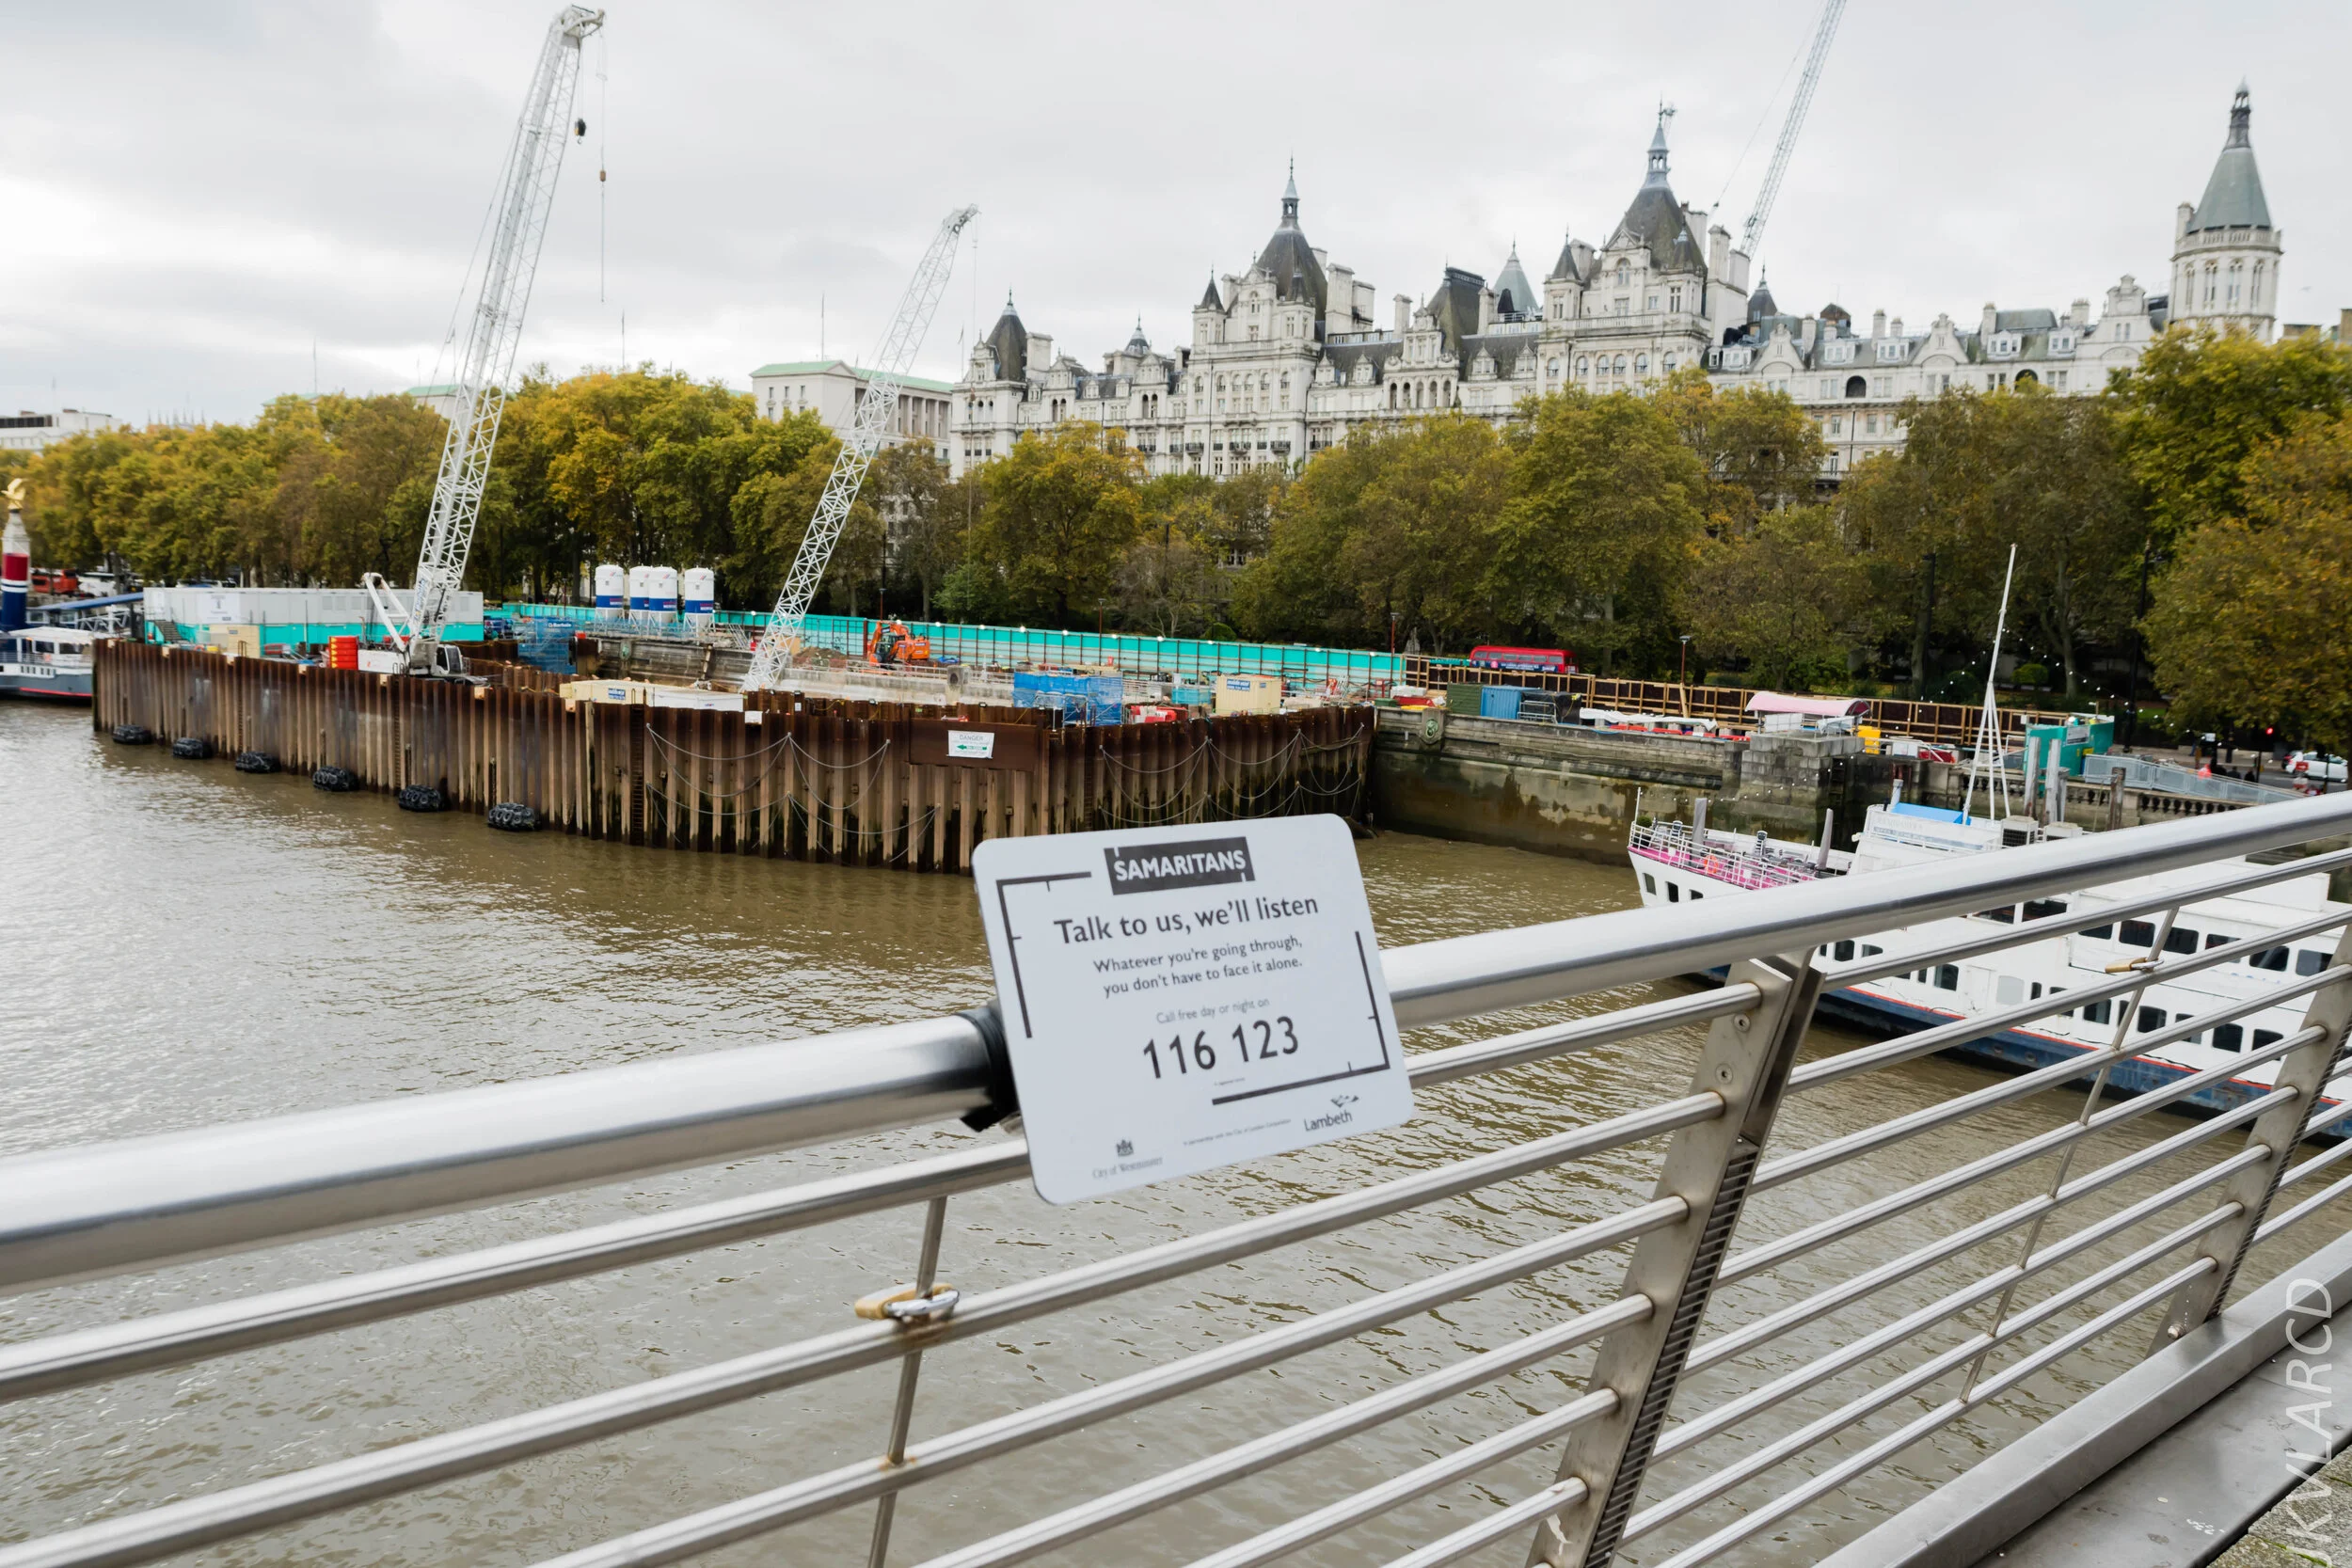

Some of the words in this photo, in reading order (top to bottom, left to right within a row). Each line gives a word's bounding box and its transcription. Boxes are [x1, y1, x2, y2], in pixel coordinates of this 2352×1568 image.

[1114, 850, 1246, 880] SAMARITANS
[1054, 916, 1114, 943] Talk
[1120, 917, 1148, 937] to
[1156, 914, 1192, 934] us,
[1195, 898, 1249, 927] we'll
[1256, 895, 1319, 921] listen
[1093, 956, 1163, 974] Whatever
[1168, 948, 1208, 968] you're
[1213, 944, 1248, 961] going
[1250, 934, 1303, 953] through,
[1104, 983, 1129, 999] you
[1134, 975, 1168, 990] don't
[1172, 974, 1202, 985] have
[1206, 971, 1220, 980] to
[1224, 964, 1249, 977] face
[1253, 961, 1263, 973] it
[1266, 958, 1303, 972] alone.
[1156, 1010, 1176, 1024] Call
[1178, 1009, 1198, 1021] free
[1200, 1006, 1216, 1020] day
[1219, 1005, 1230, 1014] or
[1232, 1000, 1256, 1015] night
[1258, 998, 1270, 1008] on
[1142, 1030, 1216, 1079] 116
[1232, 1016, 1299, 1063] 123
[1303, 1109, 1353, 1132] Lambeth
